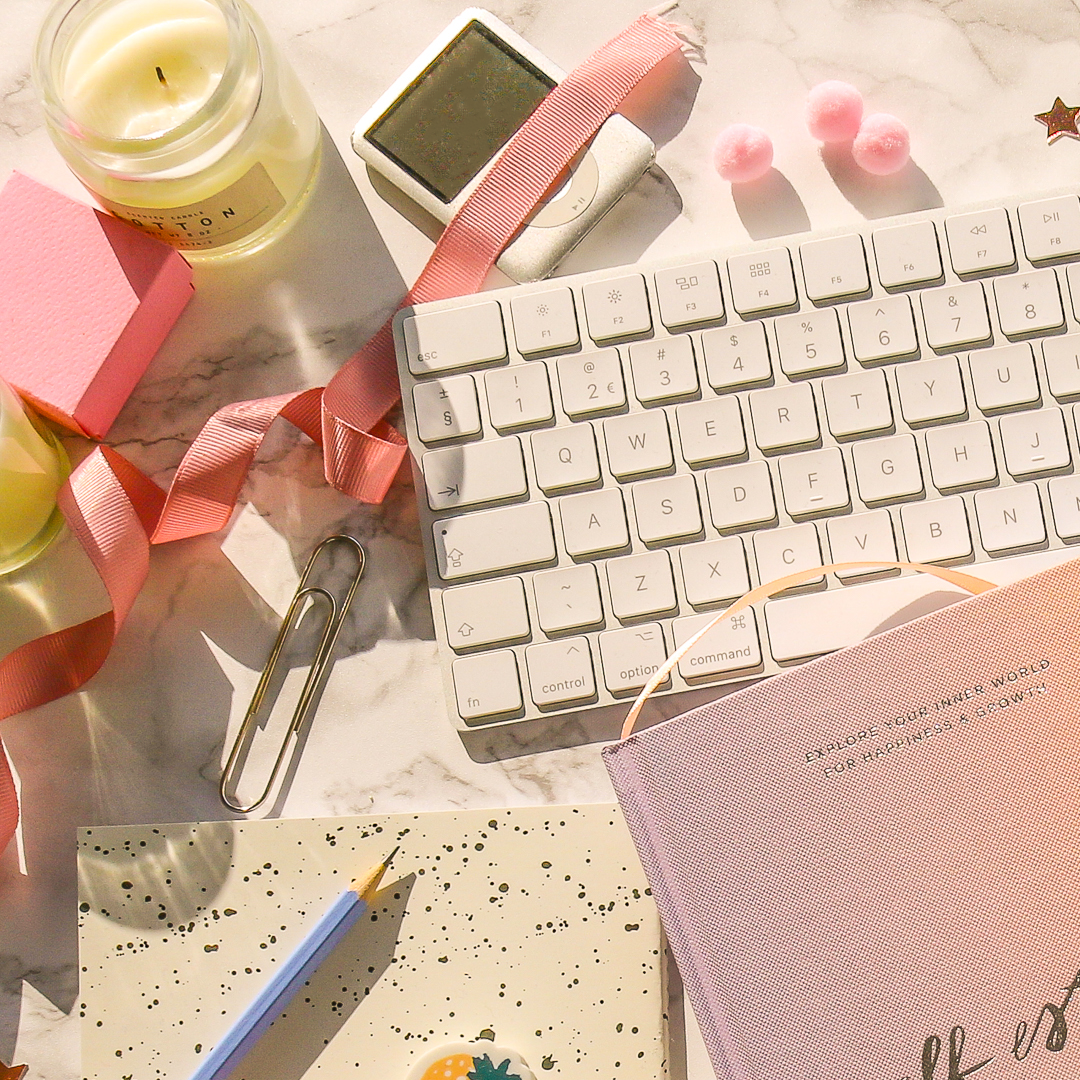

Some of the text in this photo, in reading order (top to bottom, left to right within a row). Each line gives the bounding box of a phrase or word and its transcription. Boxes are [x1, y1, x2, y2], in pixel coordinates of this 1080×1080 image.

[1050, 237, 1062, 246] F8
[976, 249, 987, 259] F7
[903, 263, 915, 272] F6
[830, 275, 843, 285] F5
[758, 289, 770, 298] F4
[685, 302, 697, 312] F3
[1024, 303, 1037, 320] 8
[612, 316, 624, 325] F2
[951, 316, 961, 333] 7
[541, 329, 551, 338] F1
[878, 330, 891, 346] 6
[417, 349, 438, 363] esc
[805, 342, 817, 359] 5
[732, 356, 745, 372] 4
[659, 370, 671, 386] 3
[996, 366, 1011, 384] U
[587, 383, 599, 400] 2
[923, 379, 936, 397] Y
[515, 397, 523, 413] 1
[850, 393, 863, 410] T
[777, 407, 791, 424] R
[704, 420, 717, 437] E
[627, 432, 646, 450] W
[1030, 432, 1040, 449] J
[558, 447, 573, 464] Q
[953, 445, 968, 463] H
[880, 459, 895, 476] G
[807, 472, 818, 489] F
[733, 486, 747, 503] D
[660, 498, 674, 515] S
[588, 513, 601, 530] A
[1003, 508, 1017, 526] N
[929, 522, 943, 539] B
[854, 533, 868, 550] V
[782, 548, 796, 565] C
[707, 561, 722, 579] X
[634, 574, 648, 592] Z
[689, 646, 751, 667] command
[619, 663, 660, 680] option
[542, 676, 586, 694] control
[467, 697, 480, 708] fn
[805, 658, 1051, 764] EXPLORE YOUR INNER WORLD
[823, 758, 856, 779] FOR
[862, 719, 953, 763] HAPPINESS
[976, 682, 1048, 719] GROWTH
